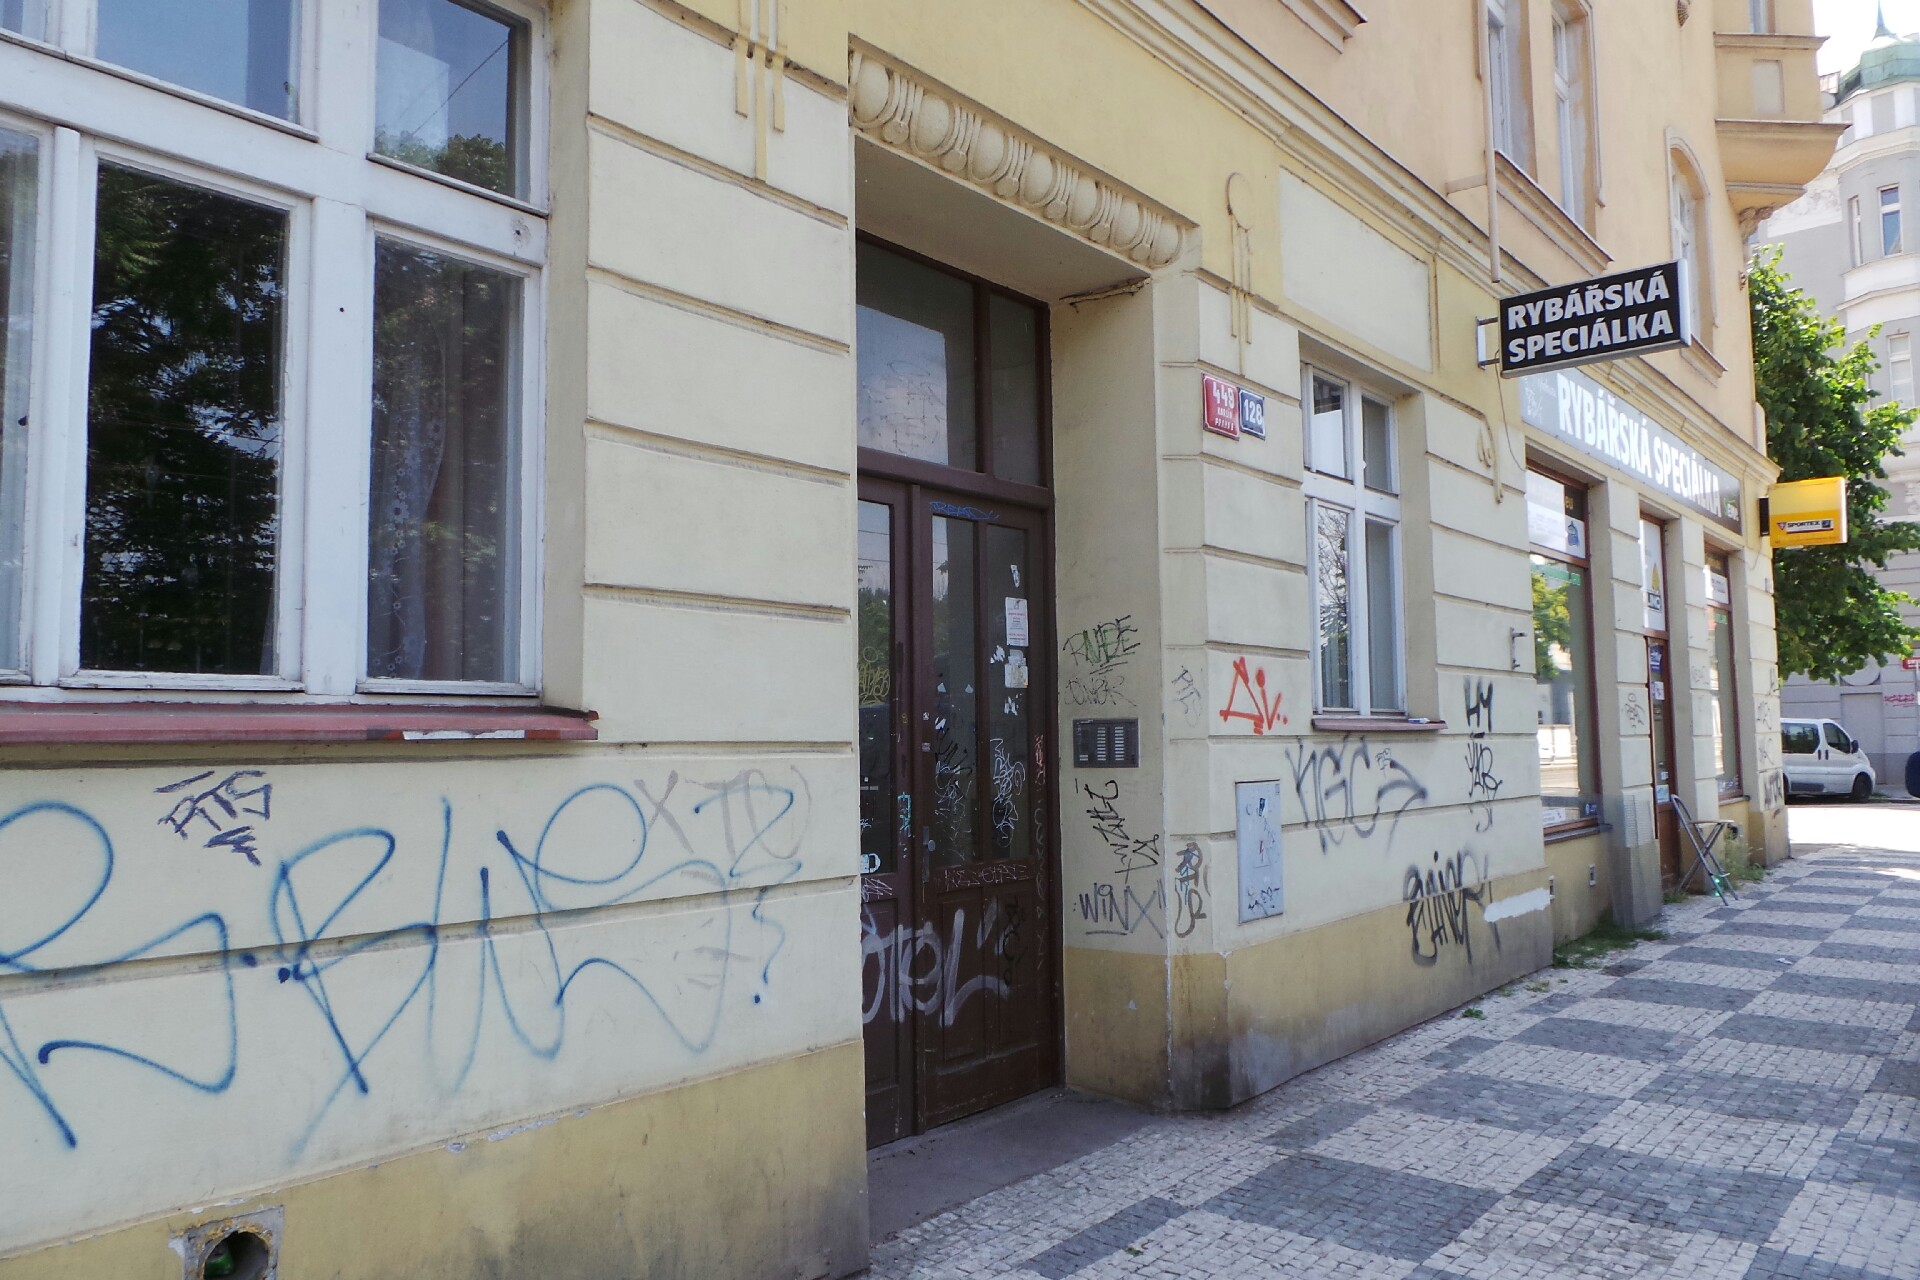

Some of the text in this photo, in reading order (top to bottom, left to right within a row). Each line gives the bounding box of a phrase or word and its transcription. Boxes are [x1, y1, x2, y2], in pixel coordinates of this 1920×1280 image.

[1507, 270, 1670, 331] RYBÁŘSKÁ
[1508, 310, 1674, 363] SPECIÁLKA
[1212, 382, 1235, 409] 449
[1244, 398, 1263, 425] 128
[1557, 372, 1652, 478] RYBÁŘSKÁ
[1653, 436, 1722, 518] SPECIÁLKA
